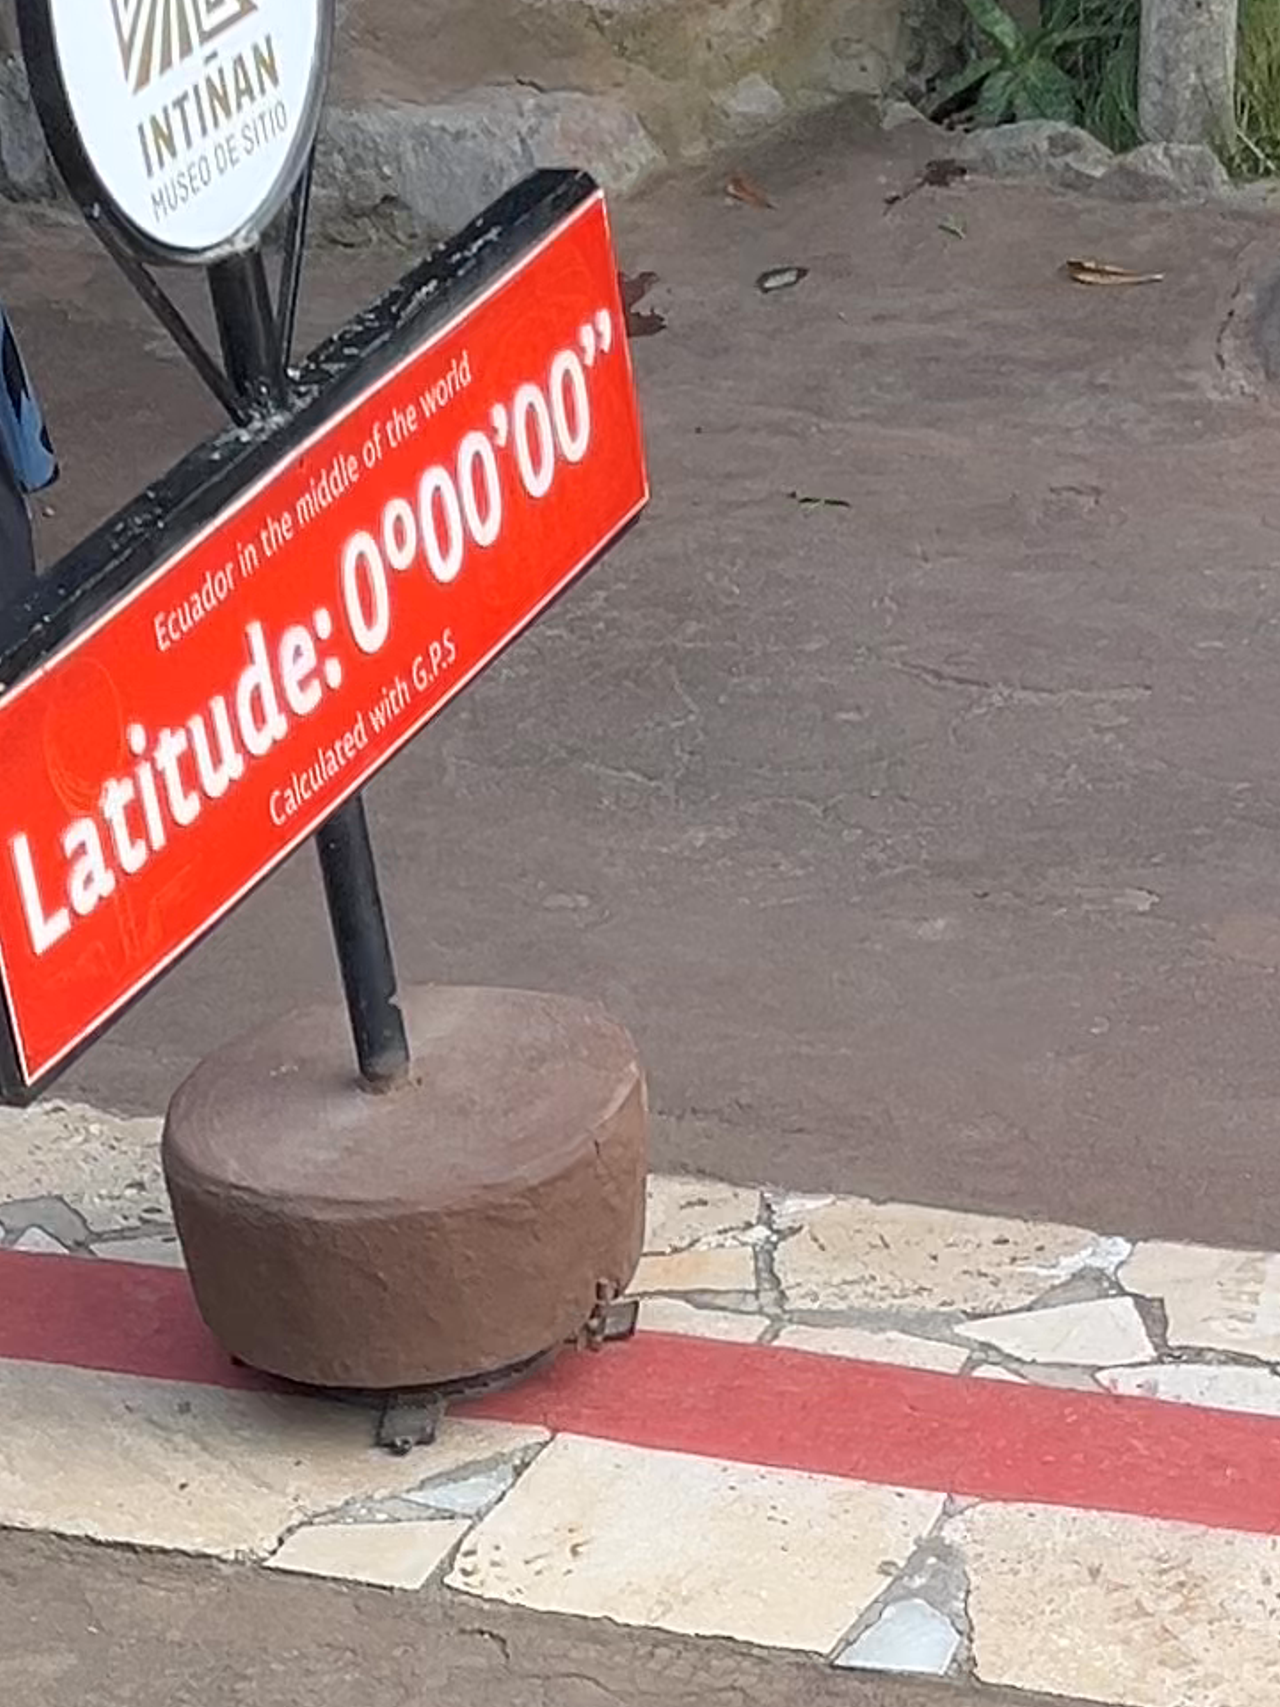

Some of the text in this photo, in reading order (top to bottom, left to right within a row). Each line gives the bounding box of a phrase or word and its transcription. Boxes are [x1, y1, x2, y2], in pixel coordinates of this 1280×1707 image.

[138, 34, 280, 179] INTIÑAN
[150, 100, 288, 223] MUSEO DE SITIO
[153, 349, 472, 652] Ecuador in the middle of the world
[9, 607, 343, 955] Latitude:
[269, 627, 456, 826] Calculated with G.P.S
